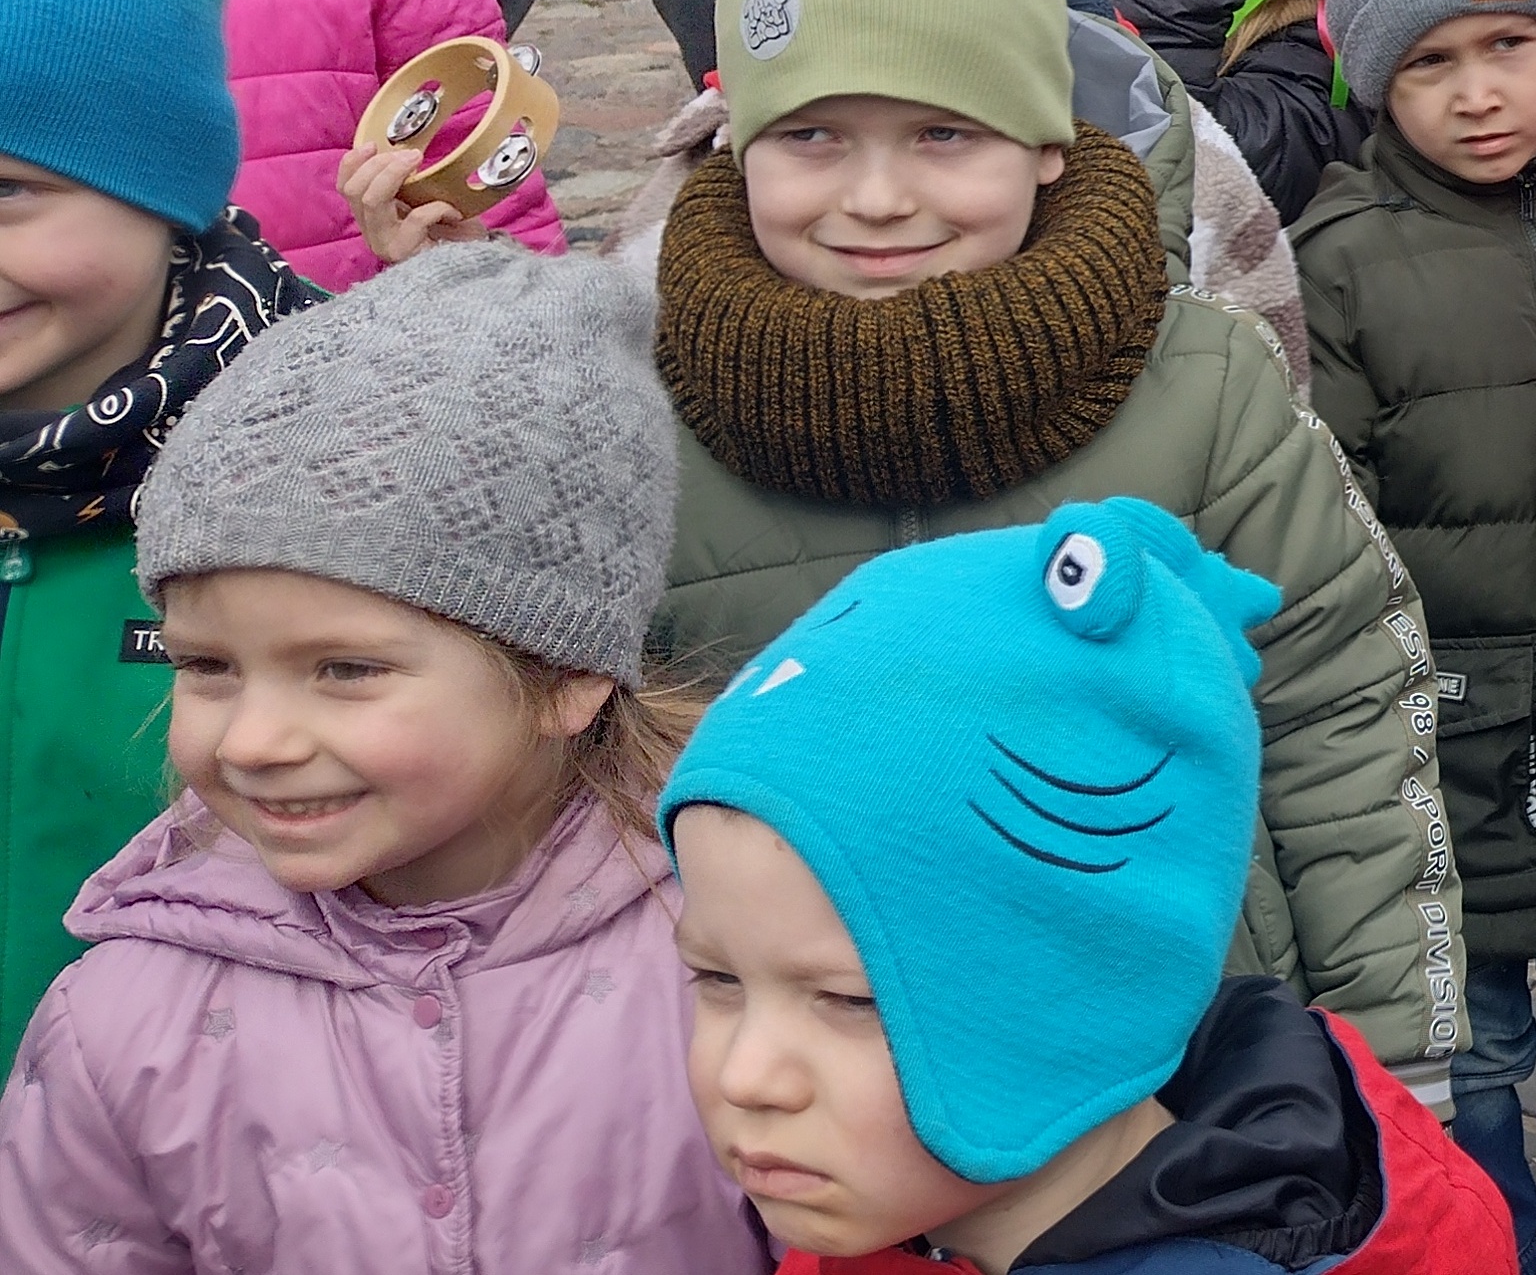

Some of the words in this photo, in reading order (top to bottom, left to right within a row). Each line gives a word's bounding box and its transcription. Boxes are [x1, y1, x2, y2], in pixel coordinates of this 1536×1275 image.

[1383, 610, 1430, 688] EST.
[1399, 692, 1435, 735] 98
[1401, 776, 1449, 895] SPORT
